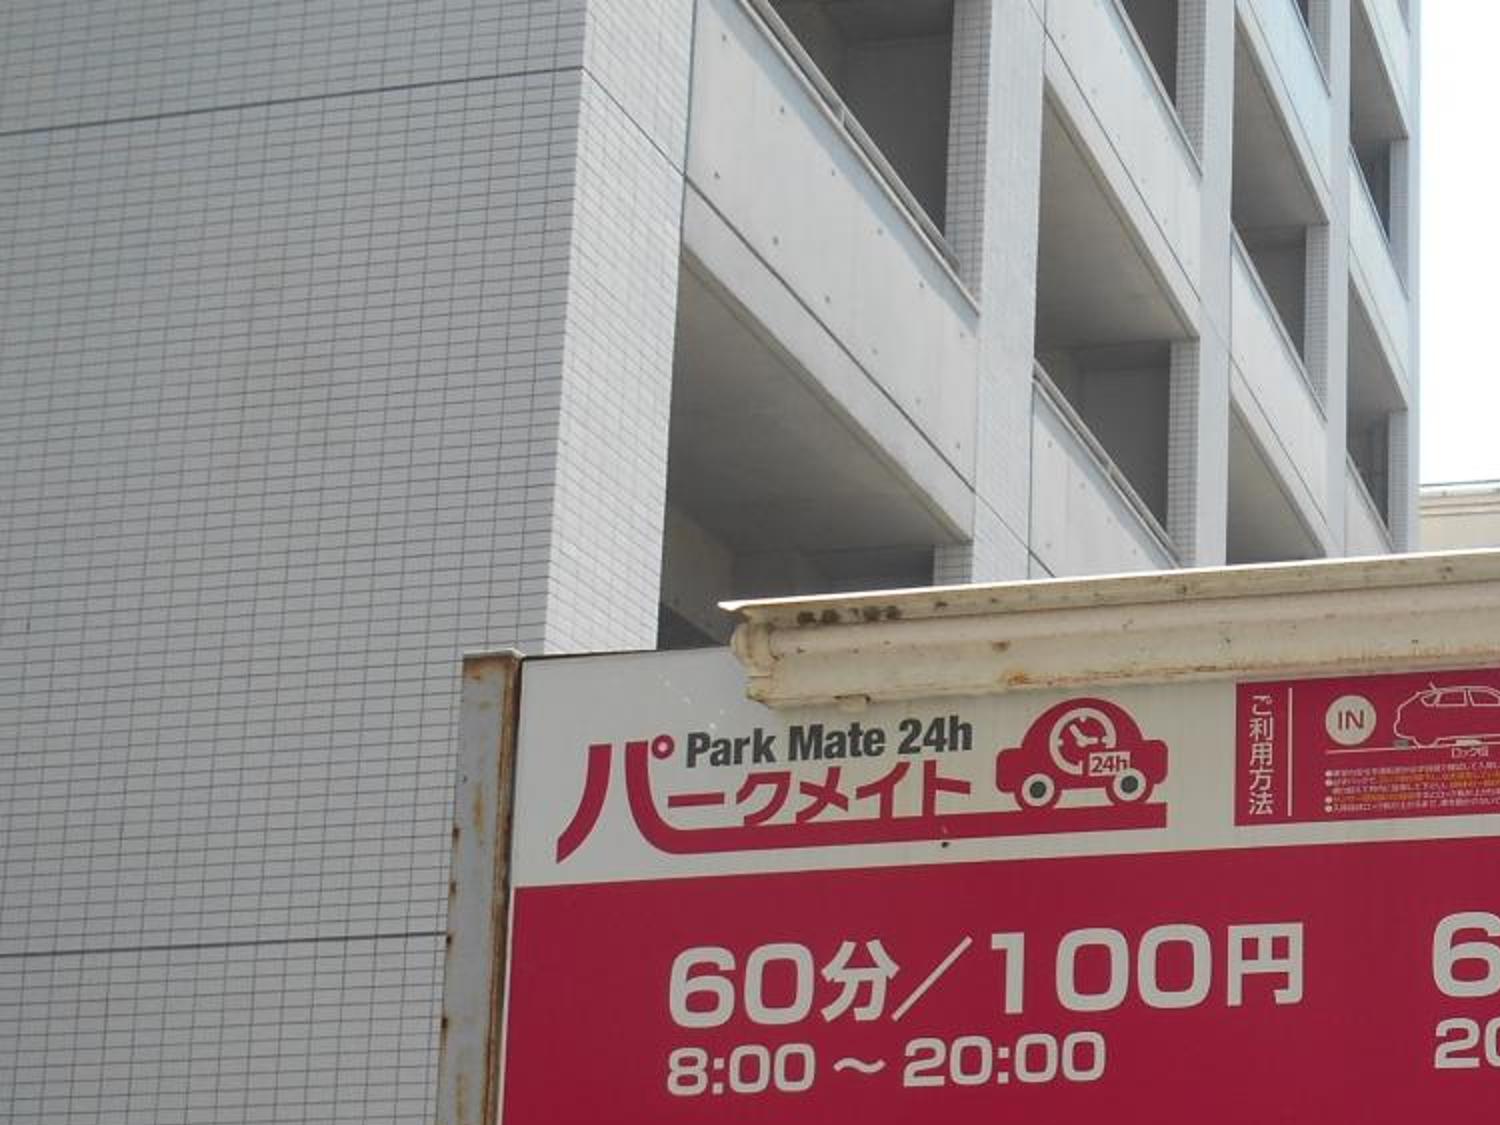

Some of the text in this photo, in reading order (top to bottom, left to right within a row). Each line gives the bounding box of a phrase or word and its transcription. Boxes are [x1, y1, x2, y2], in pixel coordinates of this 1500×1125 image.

[686, 715, 974, 769] Park Mate 24h
[1337, 709, 1365, 731] IN
[1091, 755, 1128, 773] 24h
[1248, 694, 1275, 816] ご利用方法
[556, 737, 974, 865] パークメイト
[666, 1043, 817, 1097] 8:00
[903, 1031, 1107, 1089] 20:00
